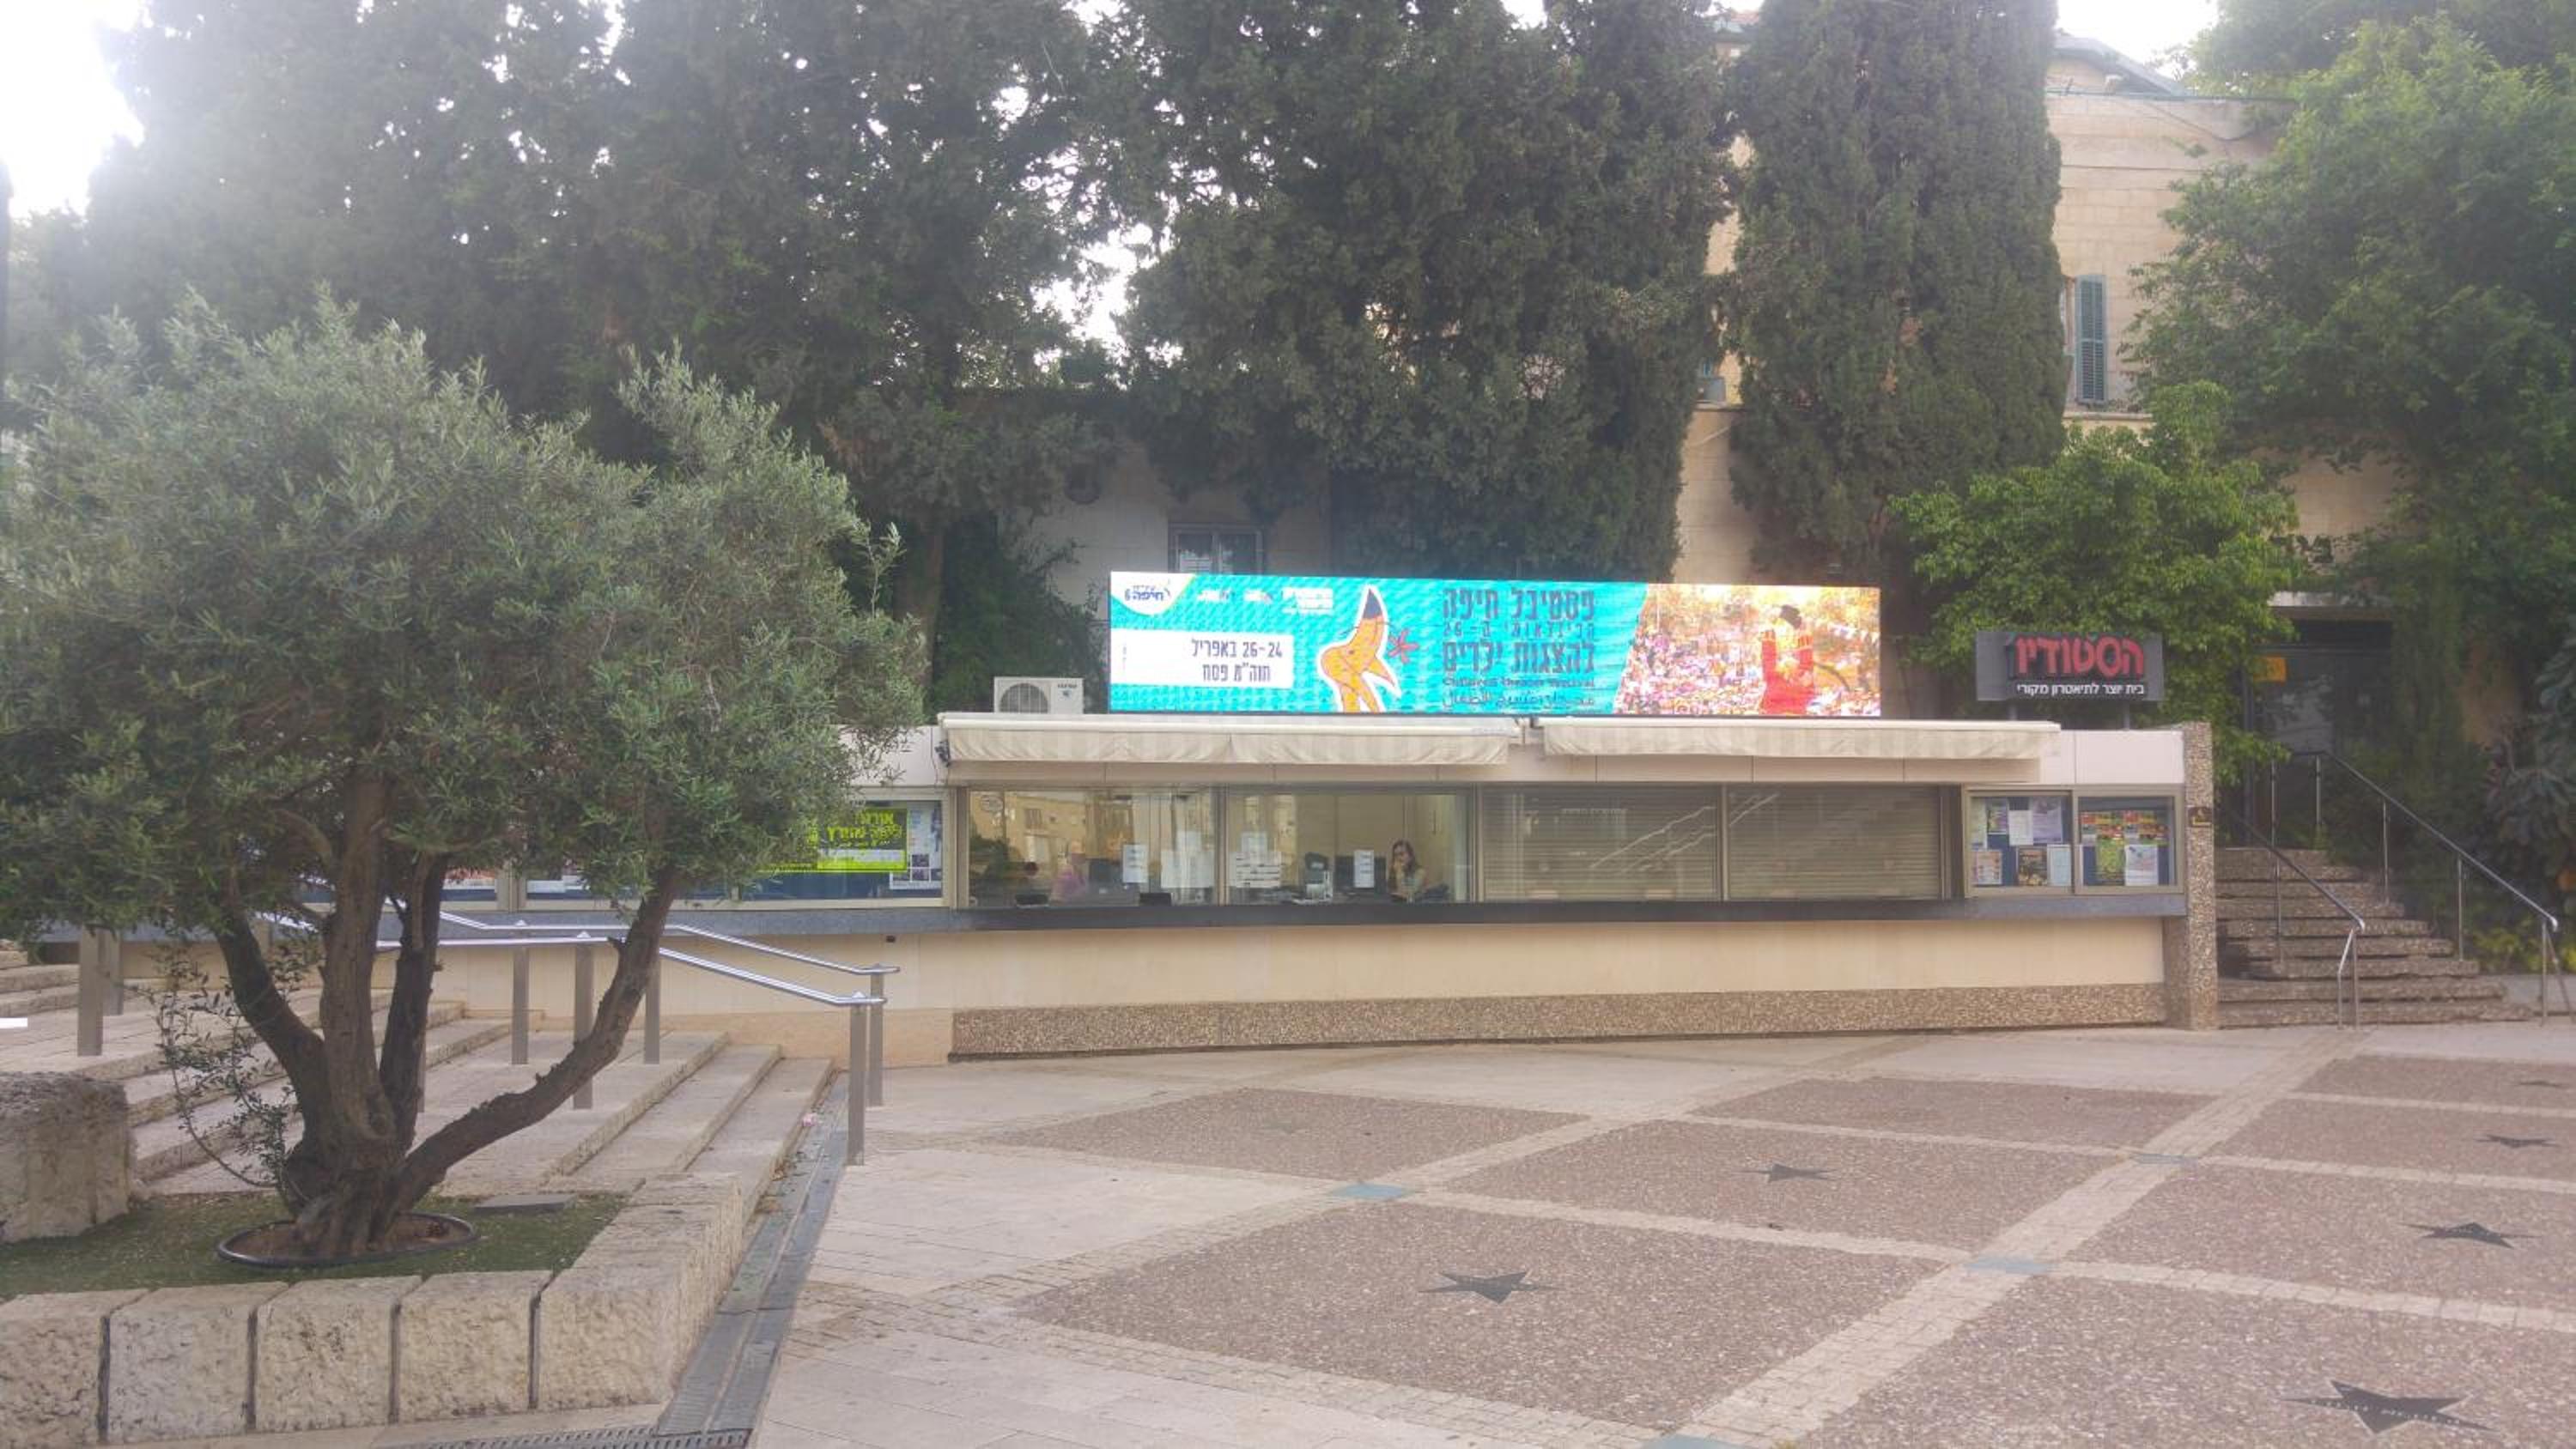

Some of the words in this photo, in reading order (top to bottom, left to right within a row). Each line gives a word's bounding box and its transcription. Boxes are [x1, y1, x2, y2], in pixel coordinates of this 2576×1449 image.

[1443, 588, 1499, 620] חיפה
[1511, 587, 1595, 621] פסטיבל
[1191, 638, 1237, 658] באפריל
[1443, 638, 1504, 672] ילדים
[1511, 640, 1595, 674] להצגות
[2014, 635, 2145, 678] הסטודיו
[1202, 664, 1229, 682] פסח
[2017, 684, 2050, 697] מקורי
[2050, 681, 2100, 697] לתיאטרון
[2102, 684, 2123, 694] יוצר
[2125, 684, 2145, 694] בית
